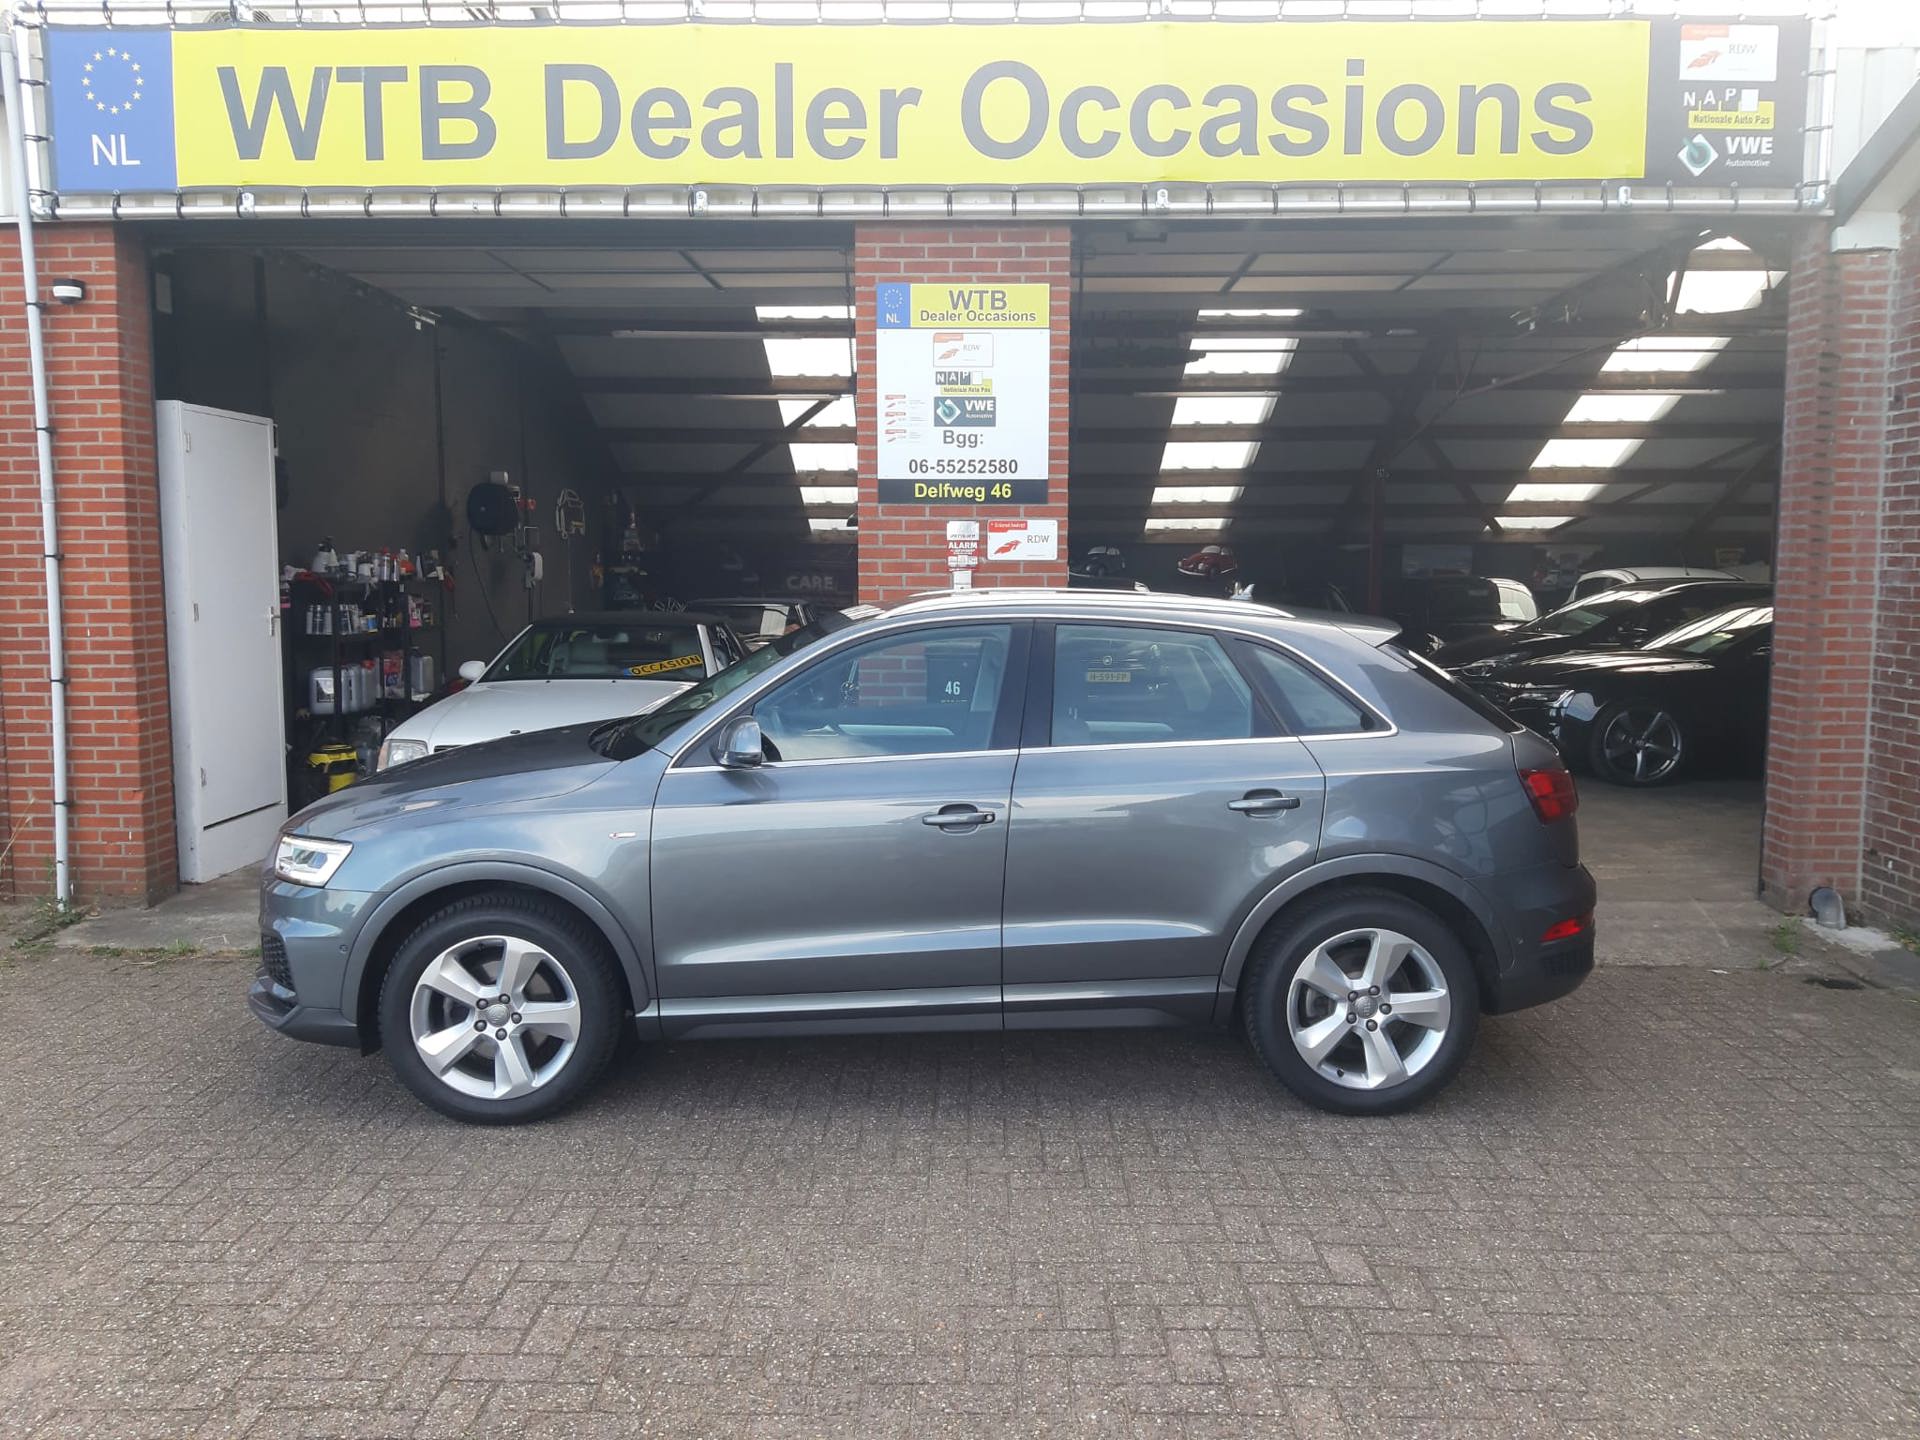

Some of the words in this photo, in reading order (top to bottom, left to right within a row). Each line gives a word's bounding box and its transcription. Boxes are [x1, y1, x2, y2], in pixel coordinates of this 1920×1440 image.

[217, 64, 498, 162] WTB
[544, 61, 922, 161] Dealer
[960, 58, 1594, 160] Occasions
[1734, 115, 1754, 125] Auto
[1755, 115, 1770, 125] Pas
[91, 134, 141, 166] NL
[1725, 136, 1774, 155] VWE
[1726, 158, 1770, 167] Automotive
[948, 289, 1008, 311] WTB
[886, 313, 900, 323] NL
[920, 310, 962, 322] Dealer
[966, 310, 1037, 322] Occasions
[965, 400, 994, 411] VWE
[943, 430, 984, 448] Bgg:
[908, 459, 1018, 474] 06-55252580
[914, 483, 986, 501] Delfweg
[991, 484, 1012, 498] 46
[1027, 535, 1050, 543] RDW
[631, 655, 701, 675] OCCASION
[945, 680, 961, 695] 46
